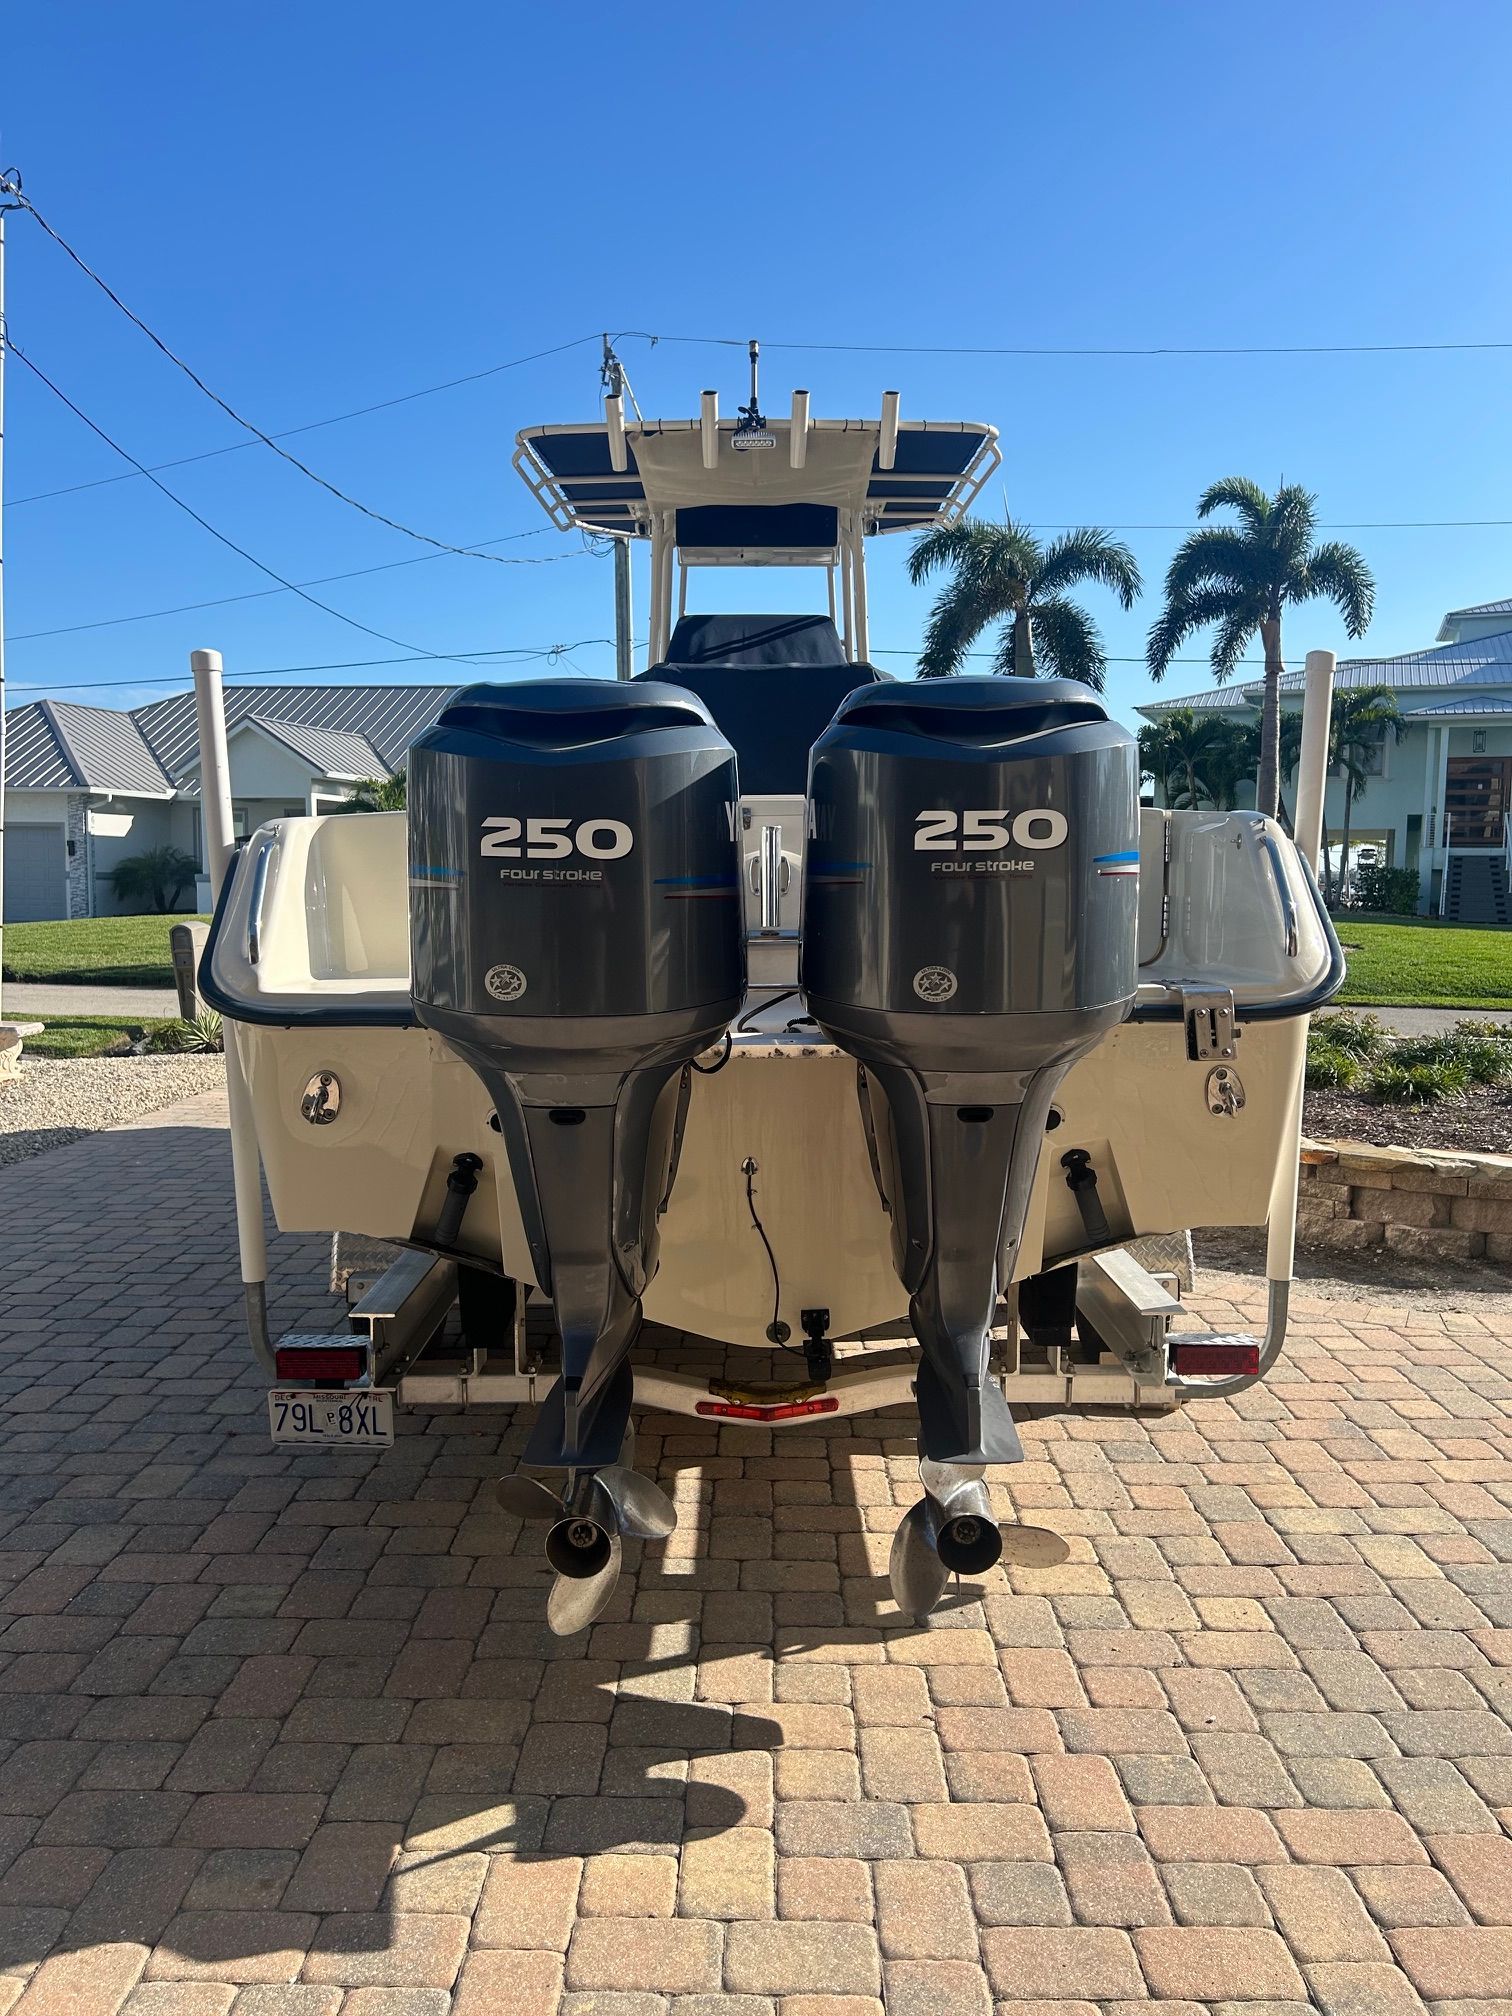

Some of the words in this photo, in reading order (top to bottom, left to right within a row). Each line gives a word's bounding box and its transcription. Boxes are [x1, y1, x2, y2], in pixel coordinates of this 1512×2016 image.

[480, 816, 634, 860] 250
[914, 808, 1069, 851] 250
[274, 1402, 324, 1433] 79L
[338, 1405, 387, 1435] 8XL
